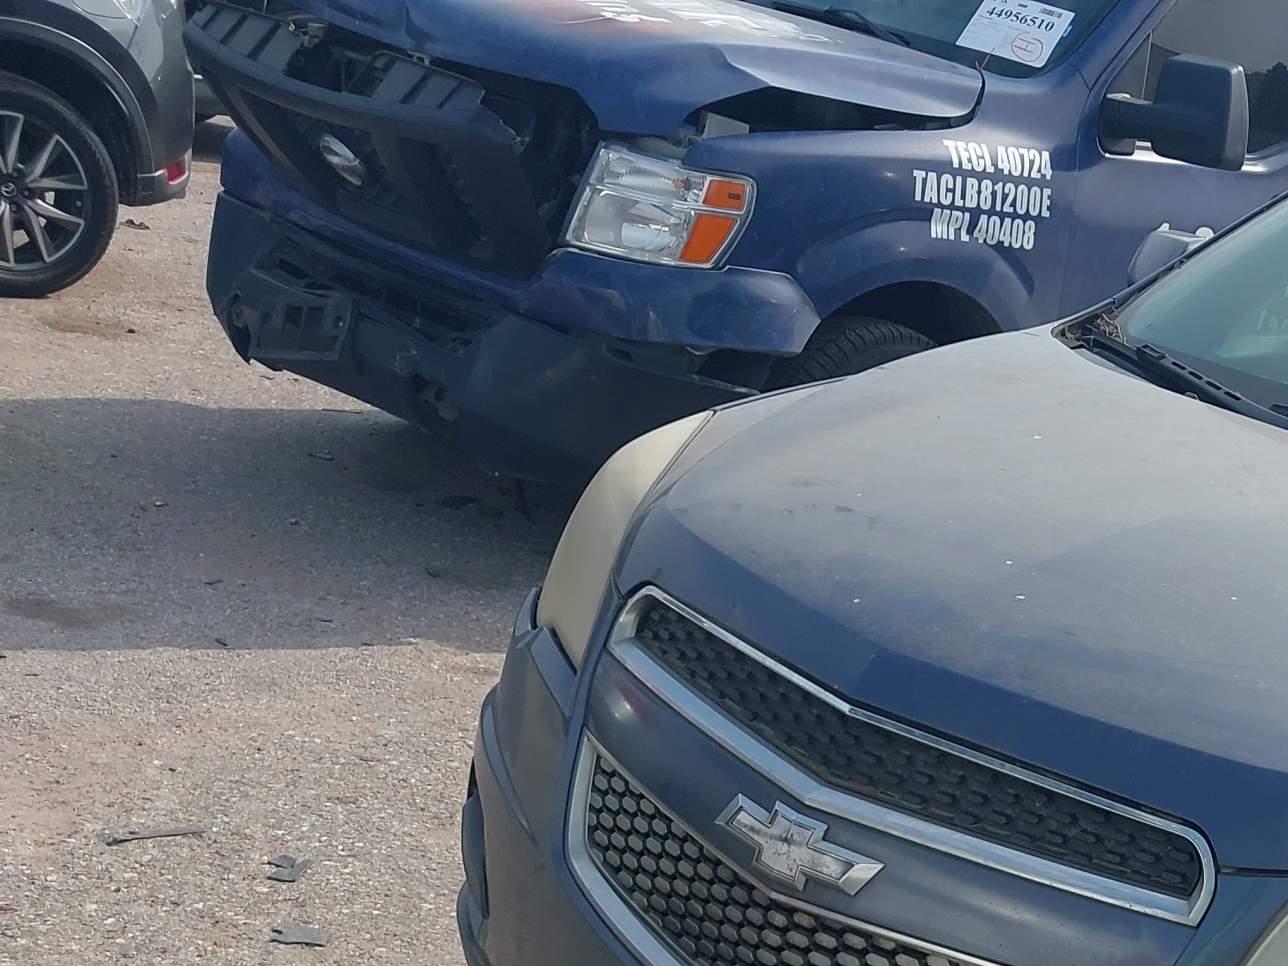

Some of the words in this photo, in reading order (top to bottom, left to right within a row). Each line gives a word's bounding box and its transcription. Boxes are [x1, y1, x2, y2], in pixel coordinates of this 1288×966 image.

[986, 6, 1056, 33] 44956510
[942, 138, 996, 174] TECL
[997, 145, 1053, 181] 40724
[912, 169, 1052, 218] TACLB81200E
[930, 207, 971, 242] MPL
[973, 214, 1036, 250] 40408
